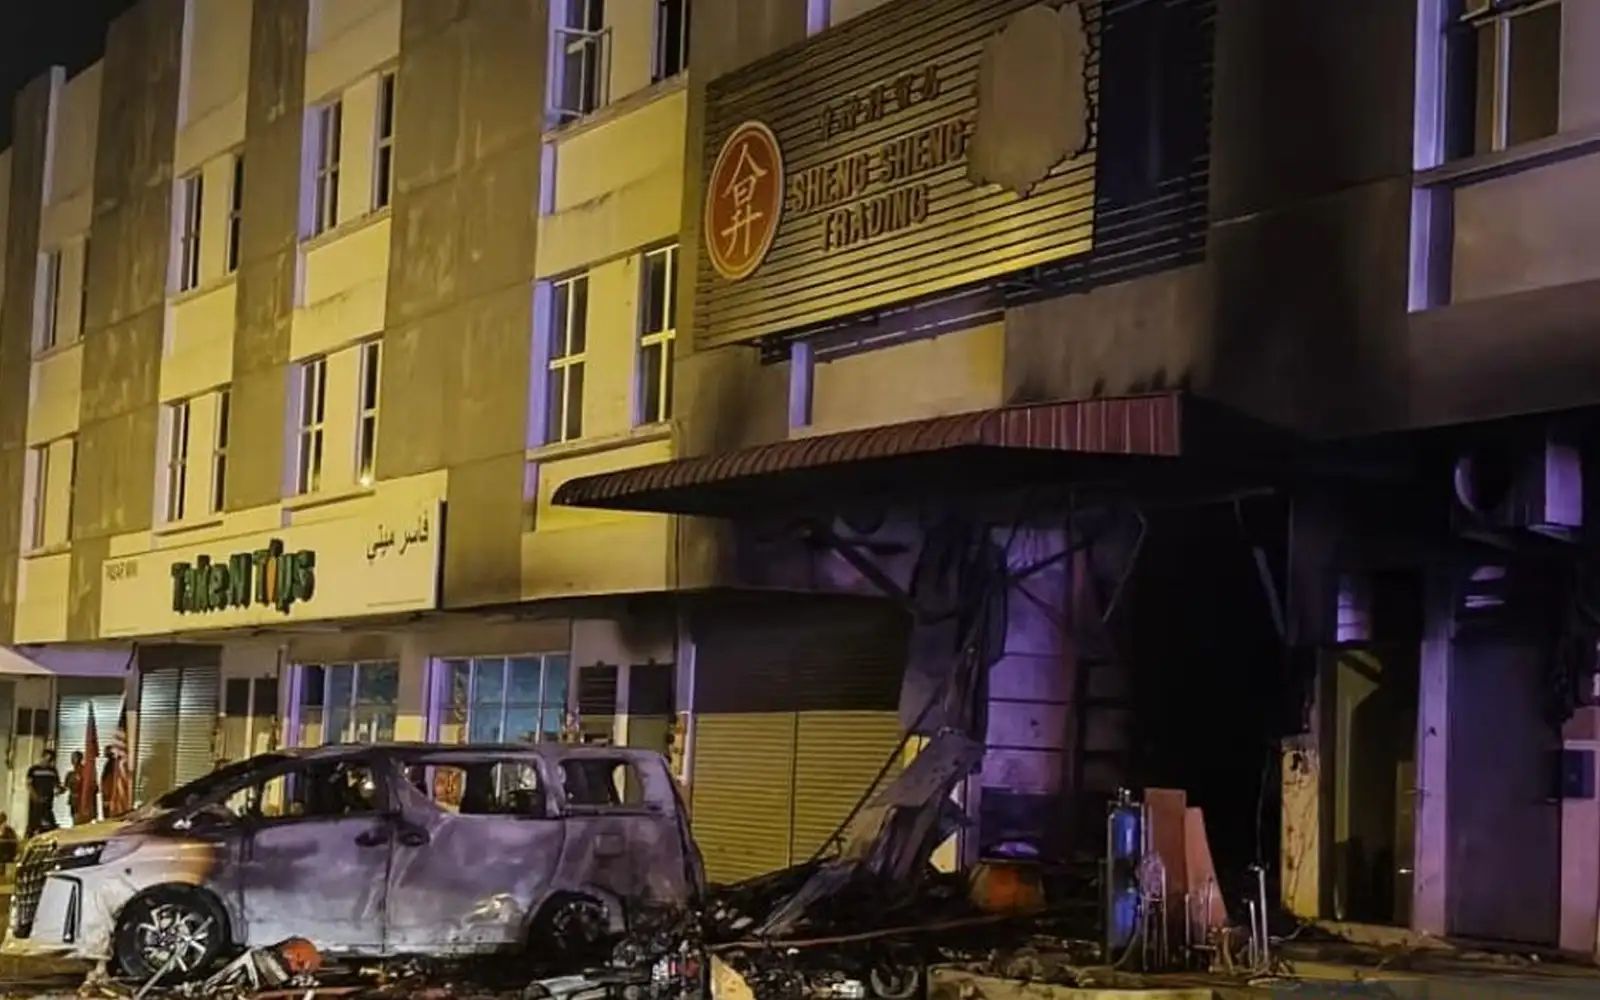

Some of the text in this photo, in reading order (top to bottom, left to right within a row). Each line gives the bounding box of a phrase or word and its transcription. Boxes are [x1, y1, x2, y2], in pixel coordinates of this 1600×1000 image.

[791, 119, 967, 212] SHENG SHENG
[822, 183, 928, 251] TRADING
